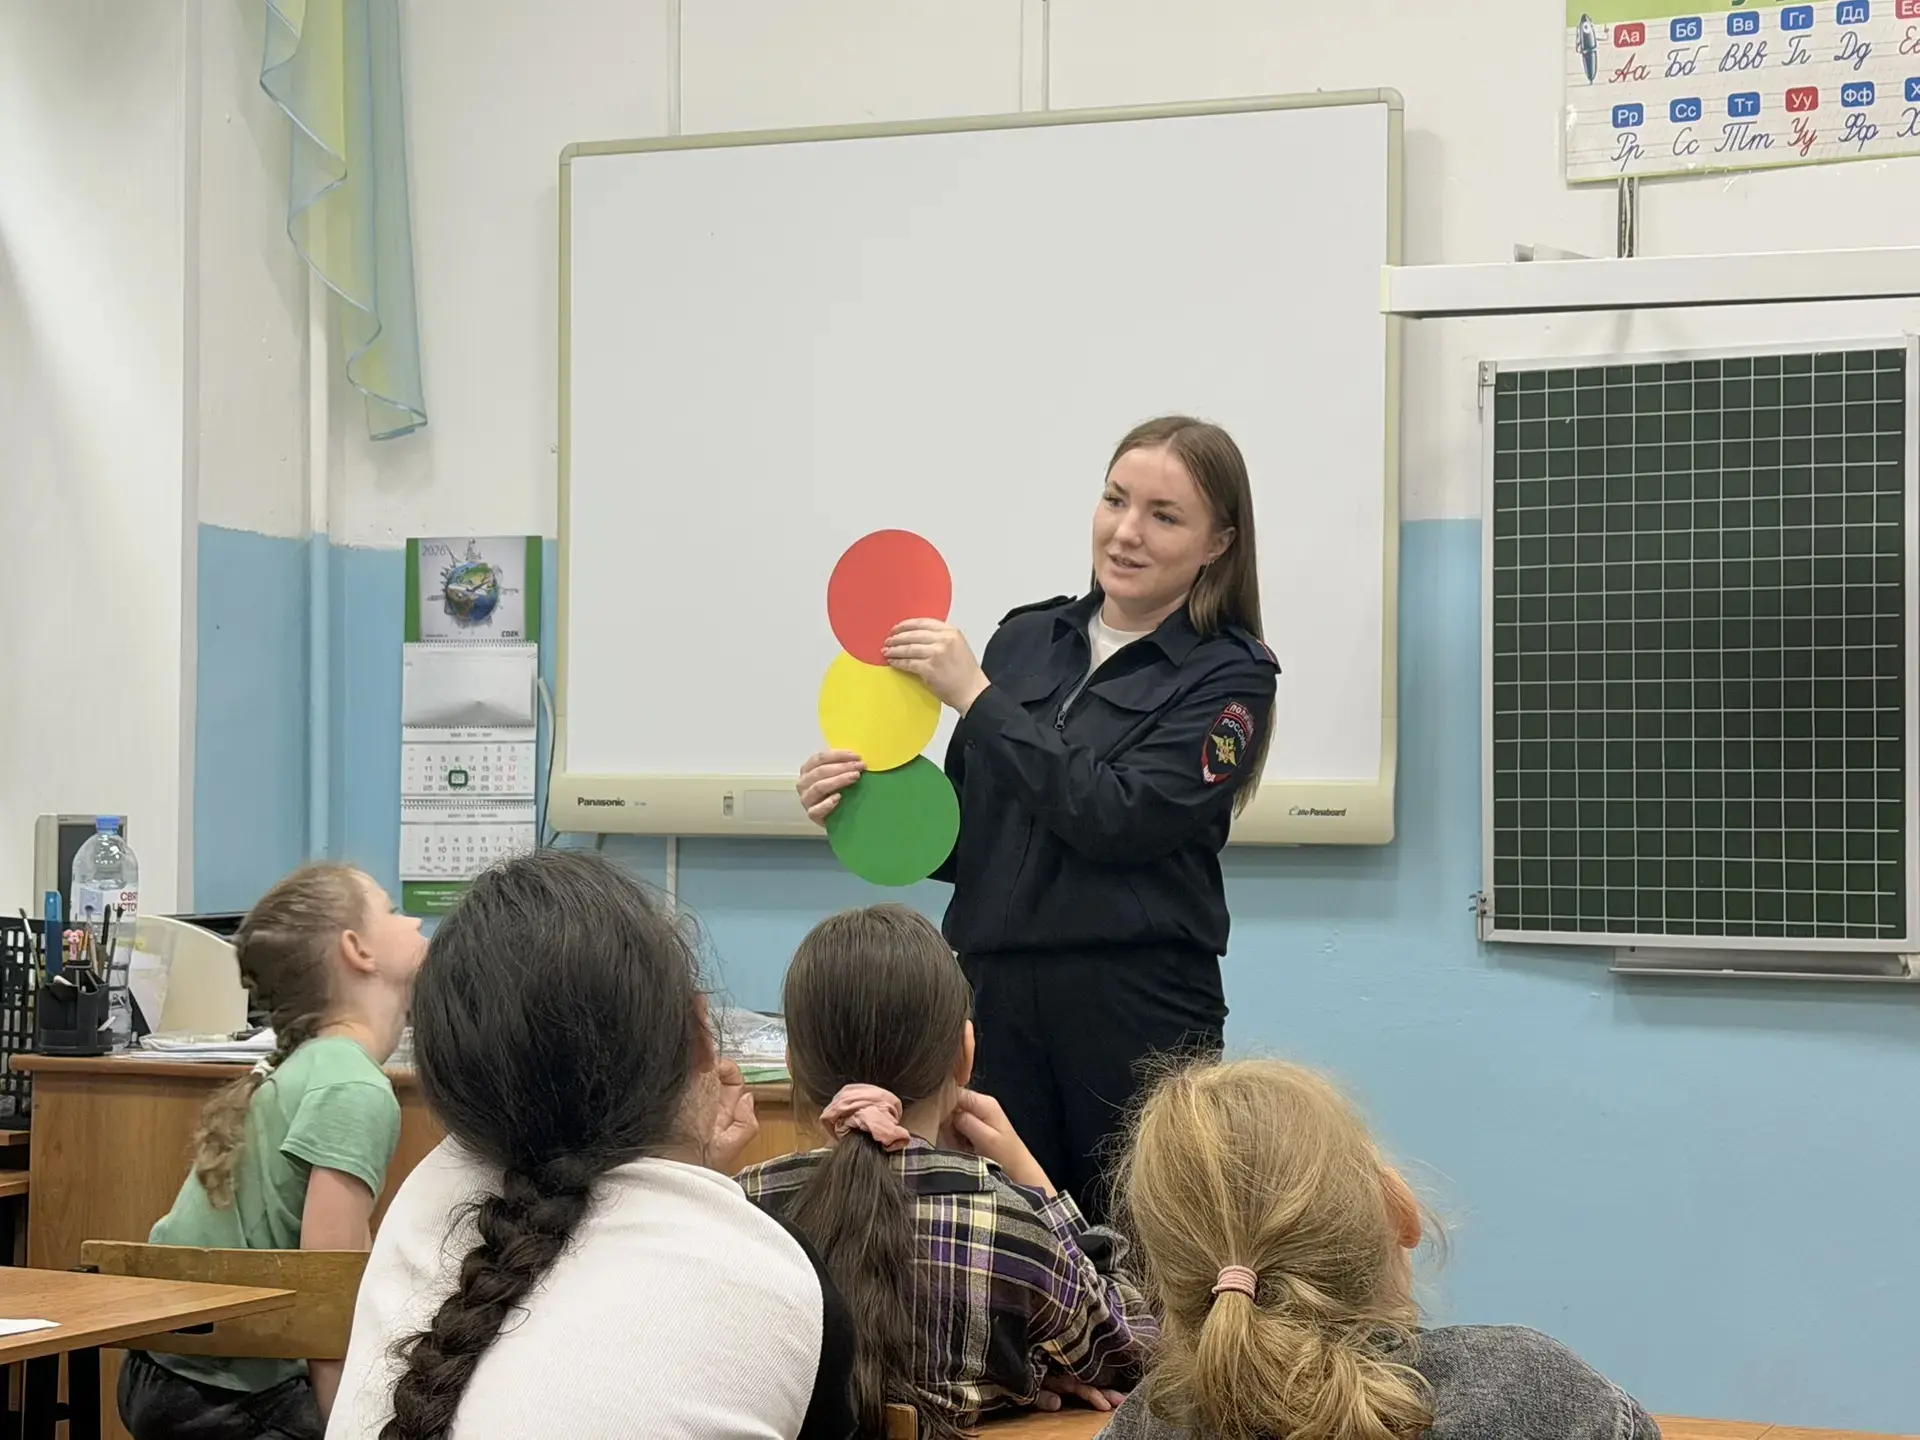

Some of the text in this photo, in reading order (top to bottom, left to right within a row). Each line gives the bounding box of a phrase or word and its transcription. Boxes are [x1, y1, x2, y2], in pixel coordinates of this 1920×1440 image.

[1618, 30, 1640, 44] Аа
[1676, 22, 1696, 38] Бб
[1733, 18, 1754, 32] Вв
[1790, 12, 1805, 26] Гг
[1840, 6, 1864, 24] Дд
[1608, 53, 1651, 83] Аа
[1665, 45, 1708, 78] Бб
[1782, 34, 1812, 66] Гг
[1618, 110, 1638, 126] Рр
[1676, 104, 1696, 118] Сс
[1735, 98, 1754, 112] Тт
[1791, 92, 1812, 110] Уу
[1844, 87, 1872, 105] Фф
[1611, 132, 1644, 172] Рр
[1672, 127, 1700, 156] Сс
[1787, 117, 1818, 156] Уу
[1838, 113, 1878, 152] Фф
[578, 796, 625, 806] Panasonic
